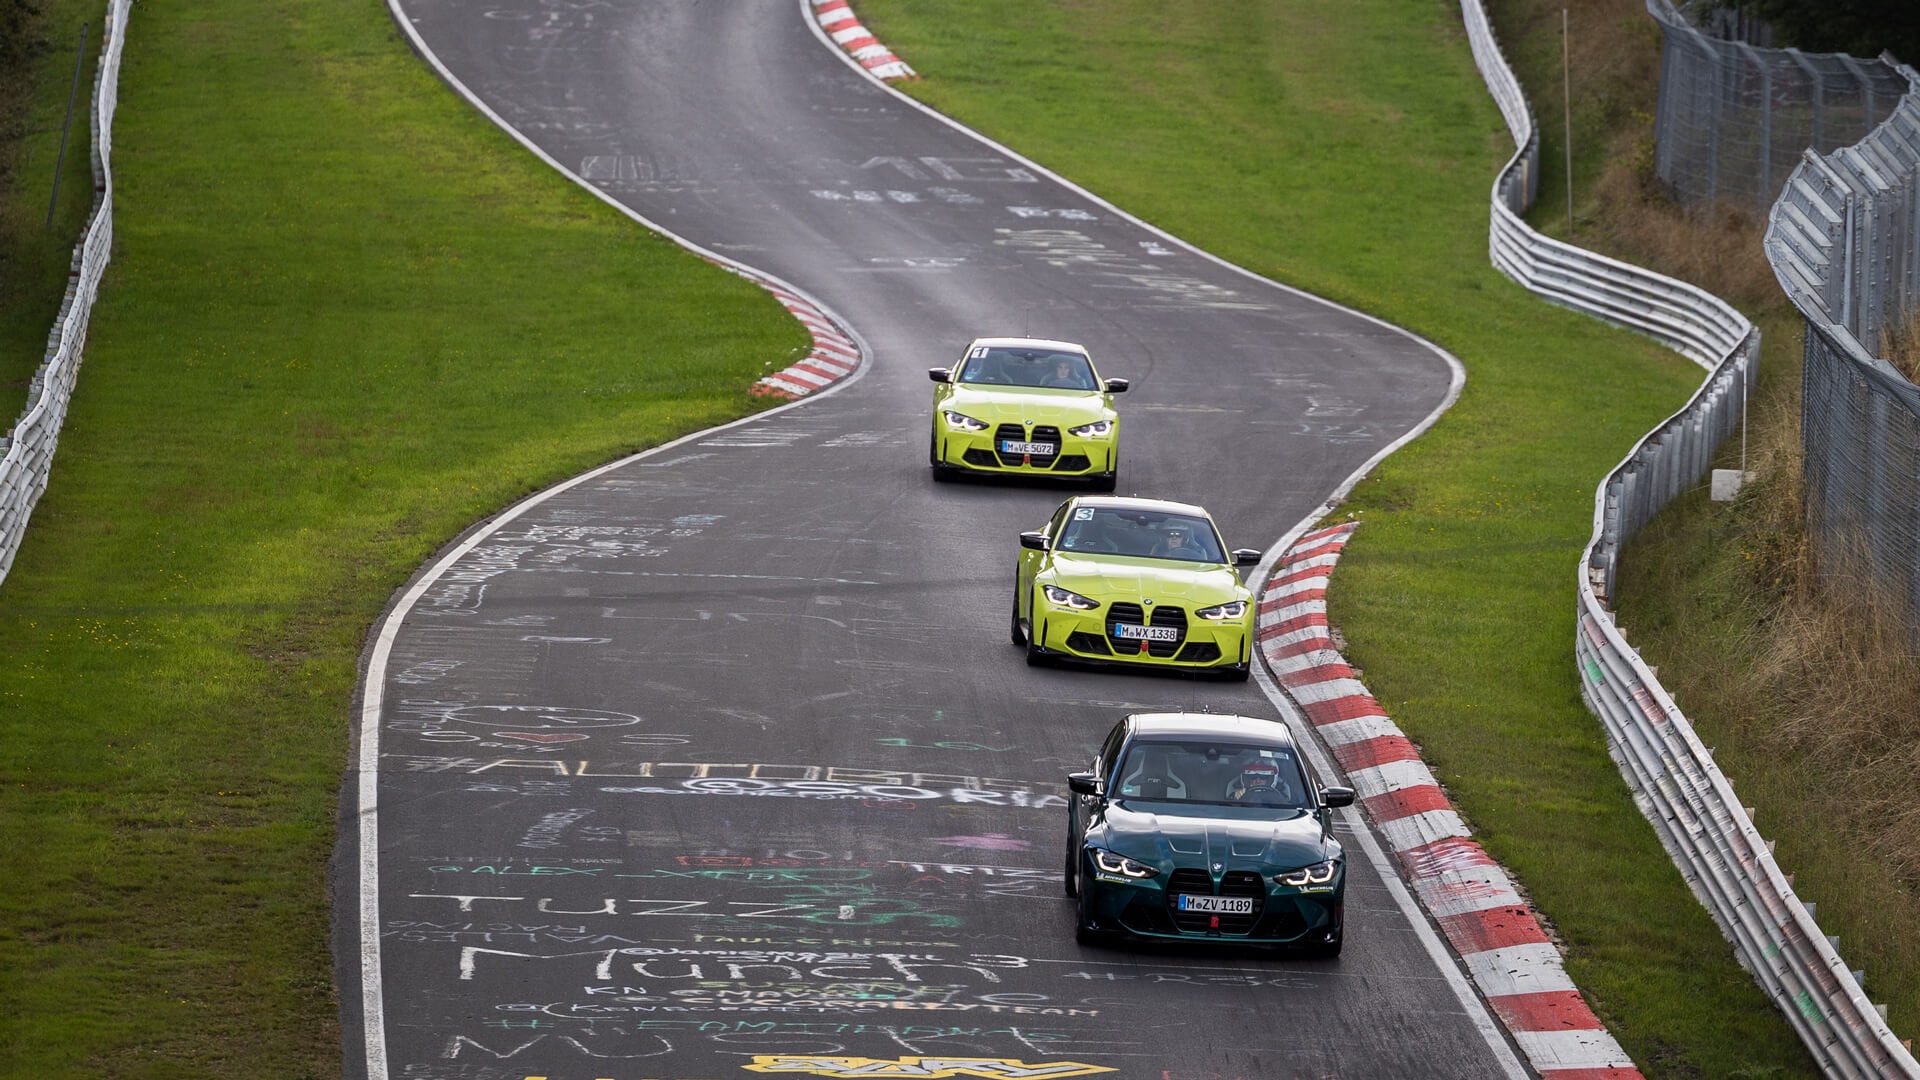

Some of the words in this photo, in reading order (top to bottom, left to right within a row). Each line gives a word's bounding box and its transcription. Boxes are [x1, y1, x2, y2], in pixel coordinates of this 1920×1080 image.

[1031, 444, 1052, 454] 5072
[1075, 508, 1093, 521] 3
[1122, 627, 1129, 637] M
[1135, 627, 1149, 638] WX
[1150, 629, 1176, 640] 1338
[1186, 897, 1196, 909] M
[1202, 898, 1219, 911] ZV
[1221, 899, 1251, 913] 1189
